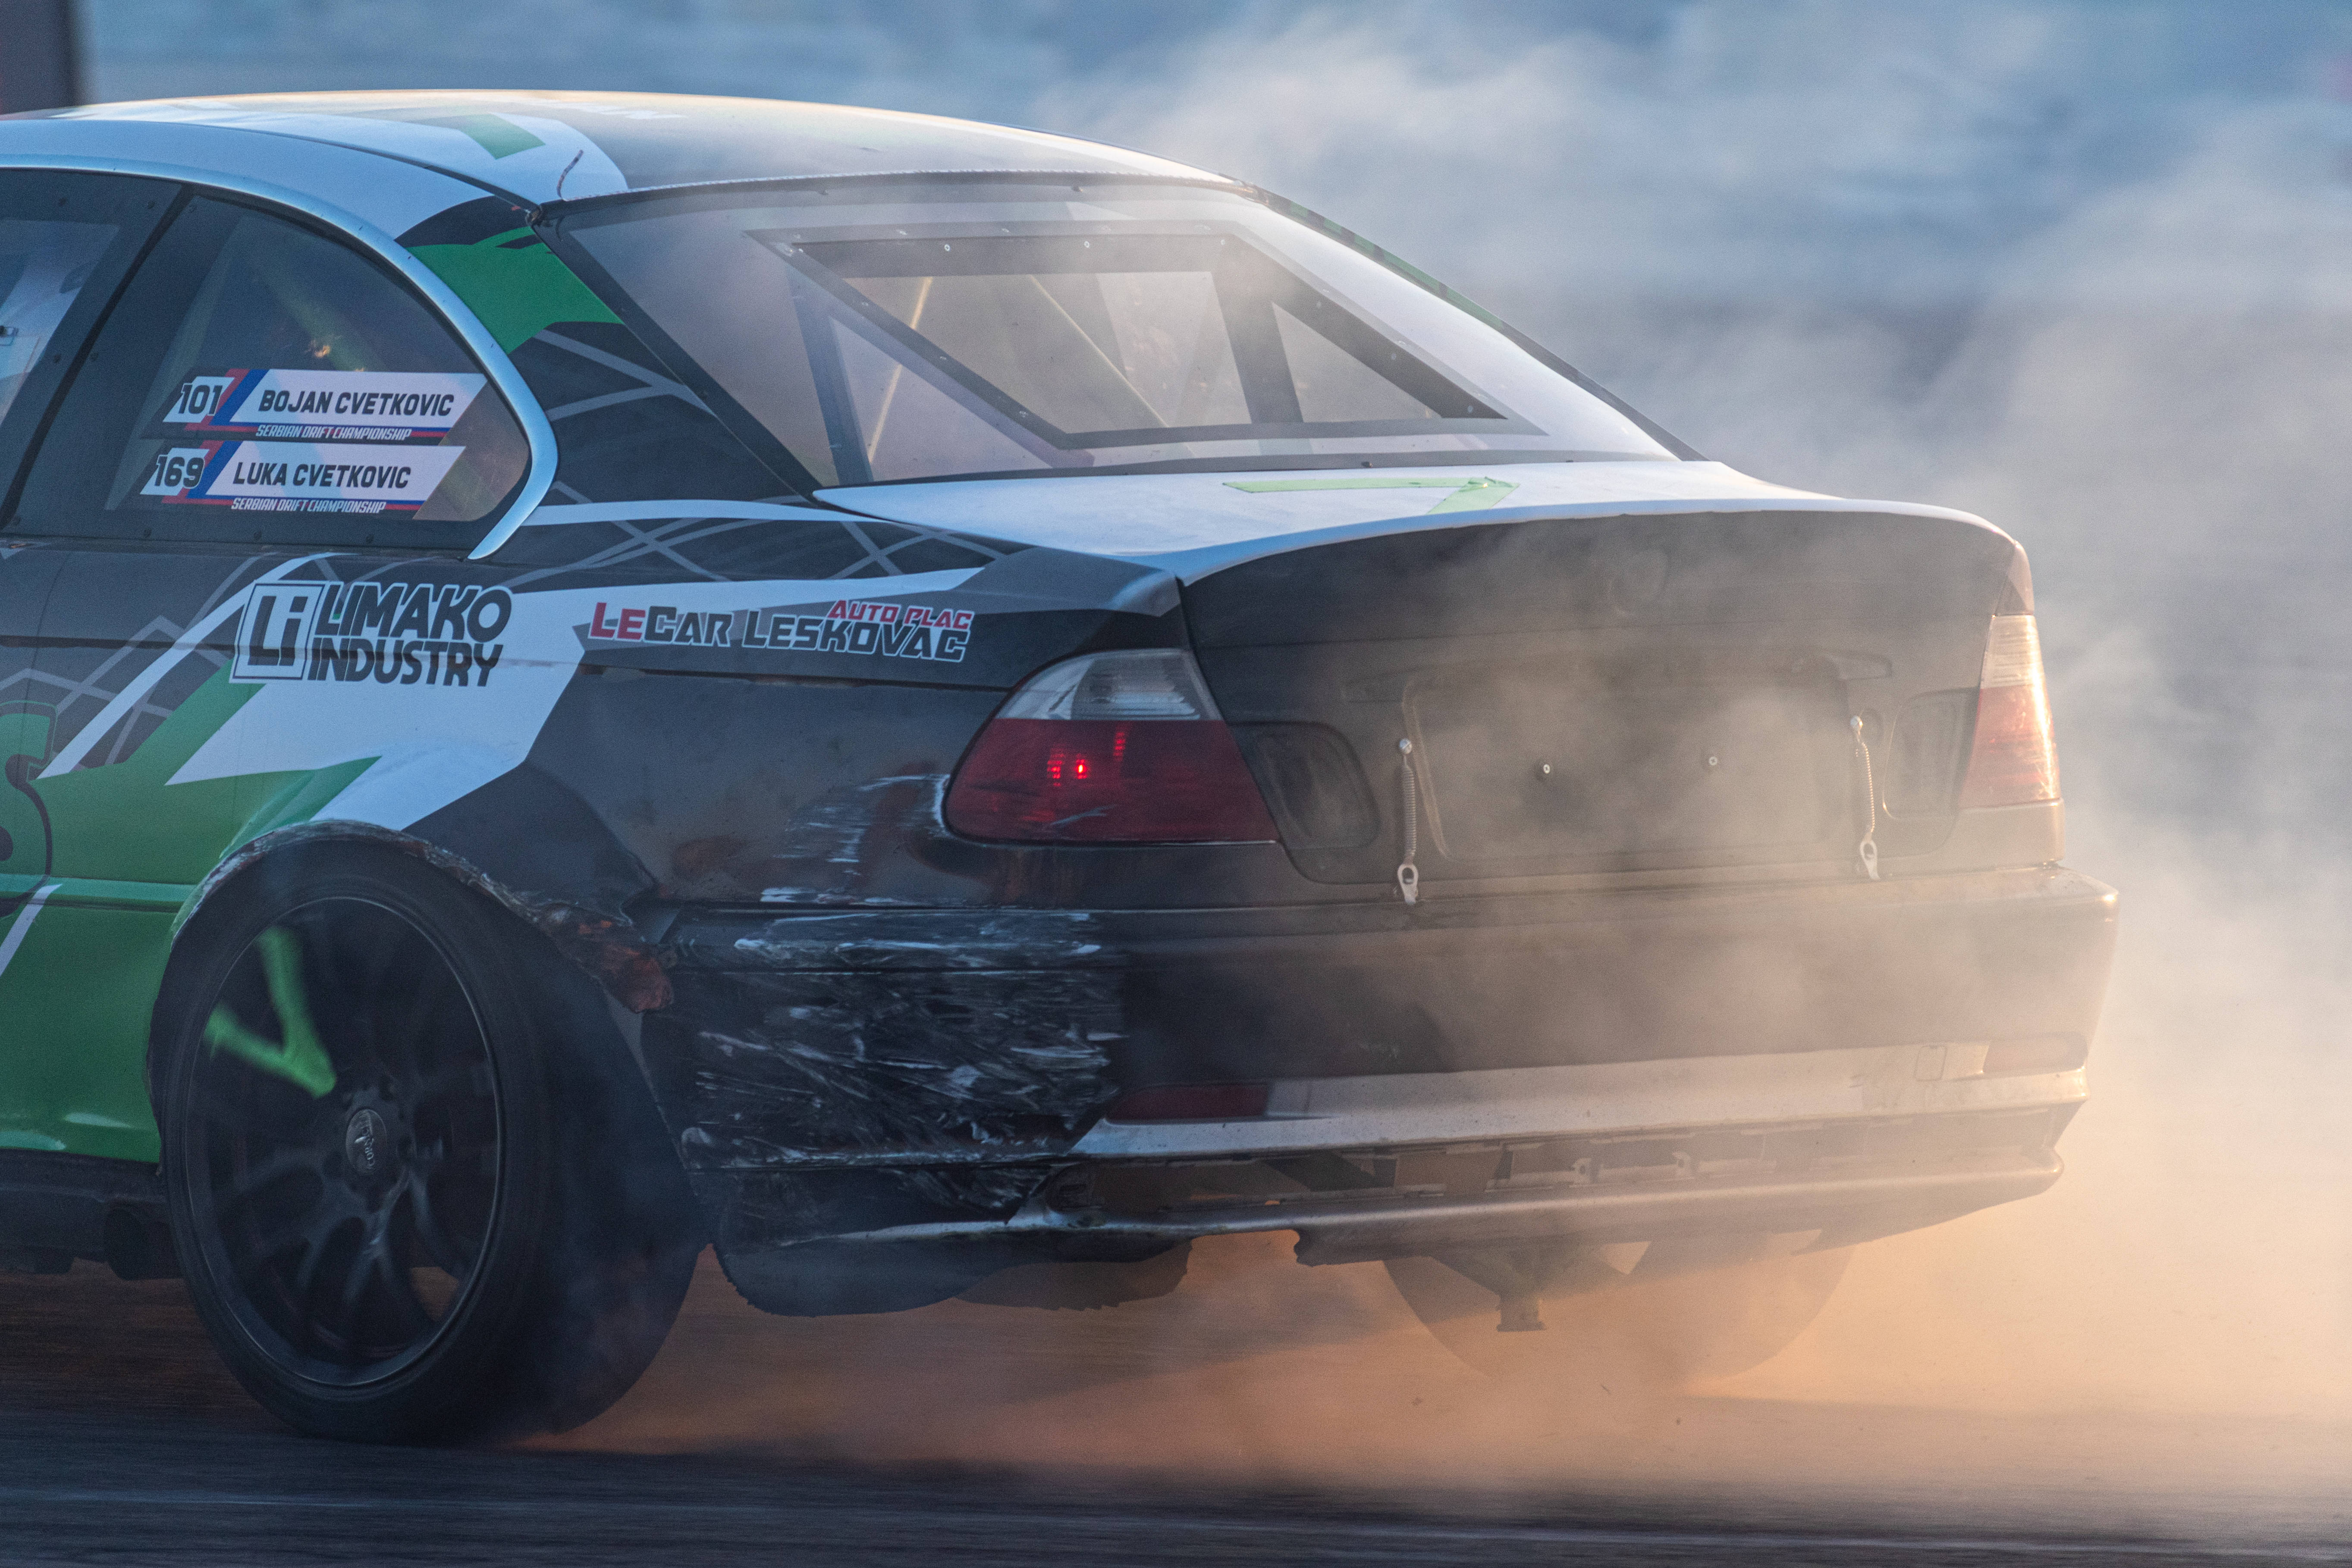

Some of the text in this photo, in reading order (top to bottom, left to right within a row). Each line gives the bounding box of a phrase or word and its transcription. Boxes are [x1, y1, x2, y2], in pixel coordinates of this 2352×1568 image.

[177, 384, 223, 415] 101
[259, 390, 454, 416] BOJAN CVETKOVIC
[255, 424, 412, 440] SERBIAN DRIFT CHAMPIONSHIP
[154, 456, 205, 488] 169
[232, 462, 411, 489] LUKA CVETKOVIC
[231, 497, 386, 513] SERBIAN DRIFT CHAMPIONSHIP
[314, 584, 512, 643] LIMAKO
[827, 600, 973, 629] AUTO PLAC
[742, 610, 970, 662] LESKOVAC
[307, 637, 504, 687] INDUSTRY
